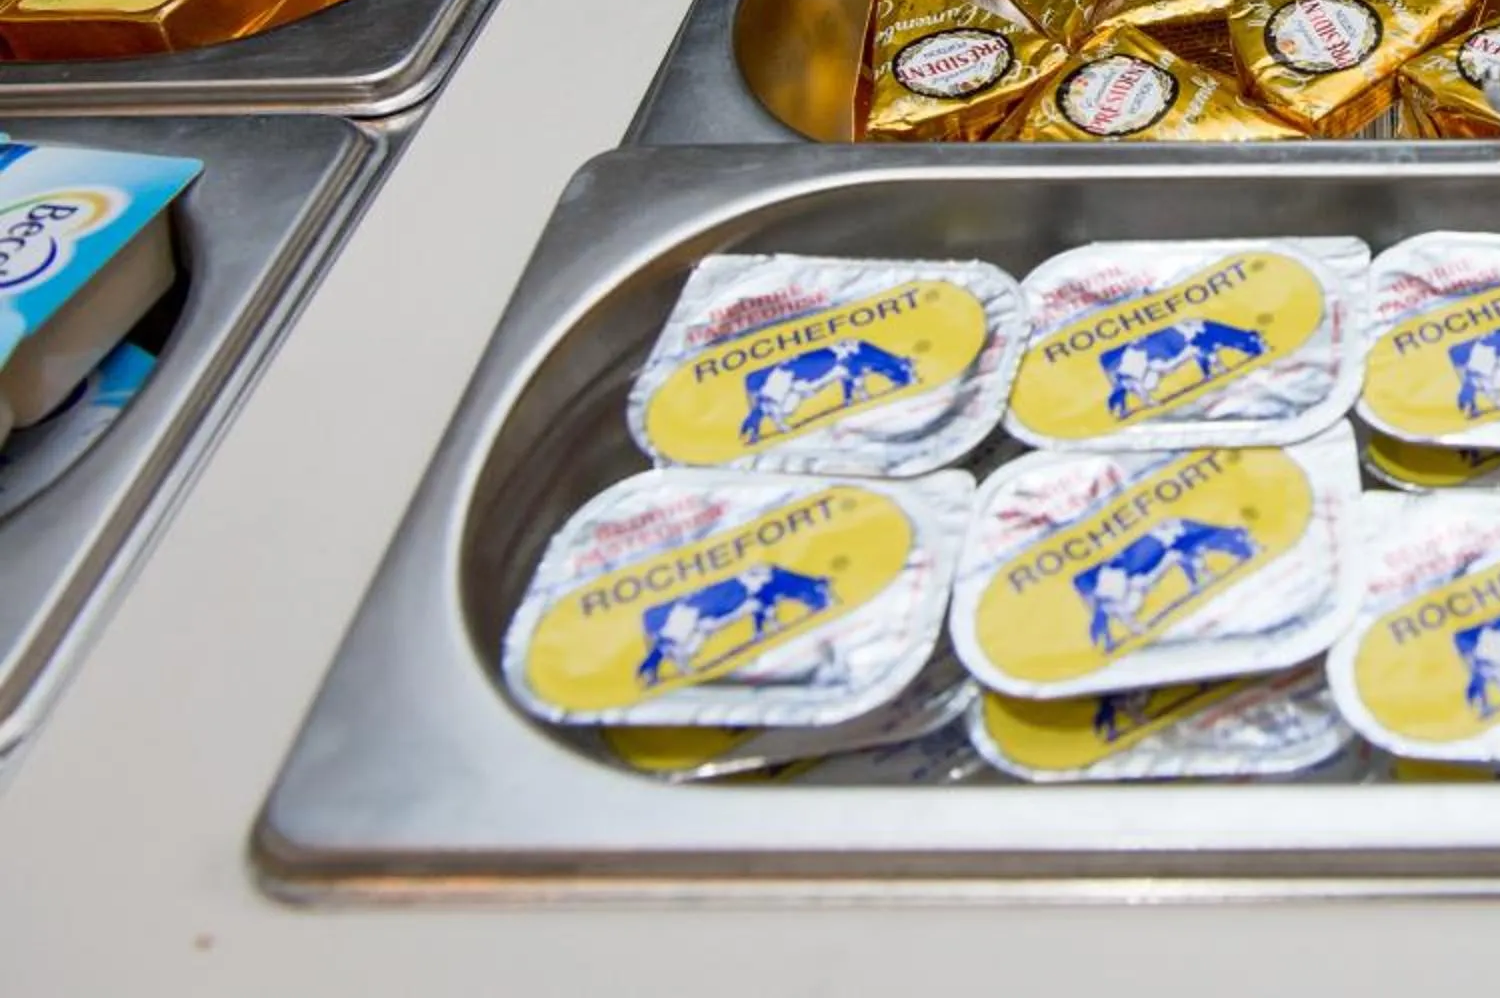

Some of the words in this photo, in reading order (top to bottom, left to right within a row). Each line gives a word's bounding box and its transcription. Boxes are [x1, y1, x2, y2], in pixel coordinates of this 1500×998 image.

[0, 204, 79, 276] Bec
[693, 287, 921, 384] ROCHEFORT
[1042, 259, 1252, 364] ROCHEFORT
[579, 495, 835, 618] ROCHEFORT
[1007, 449, 1226, 595] ROCHEFORT
